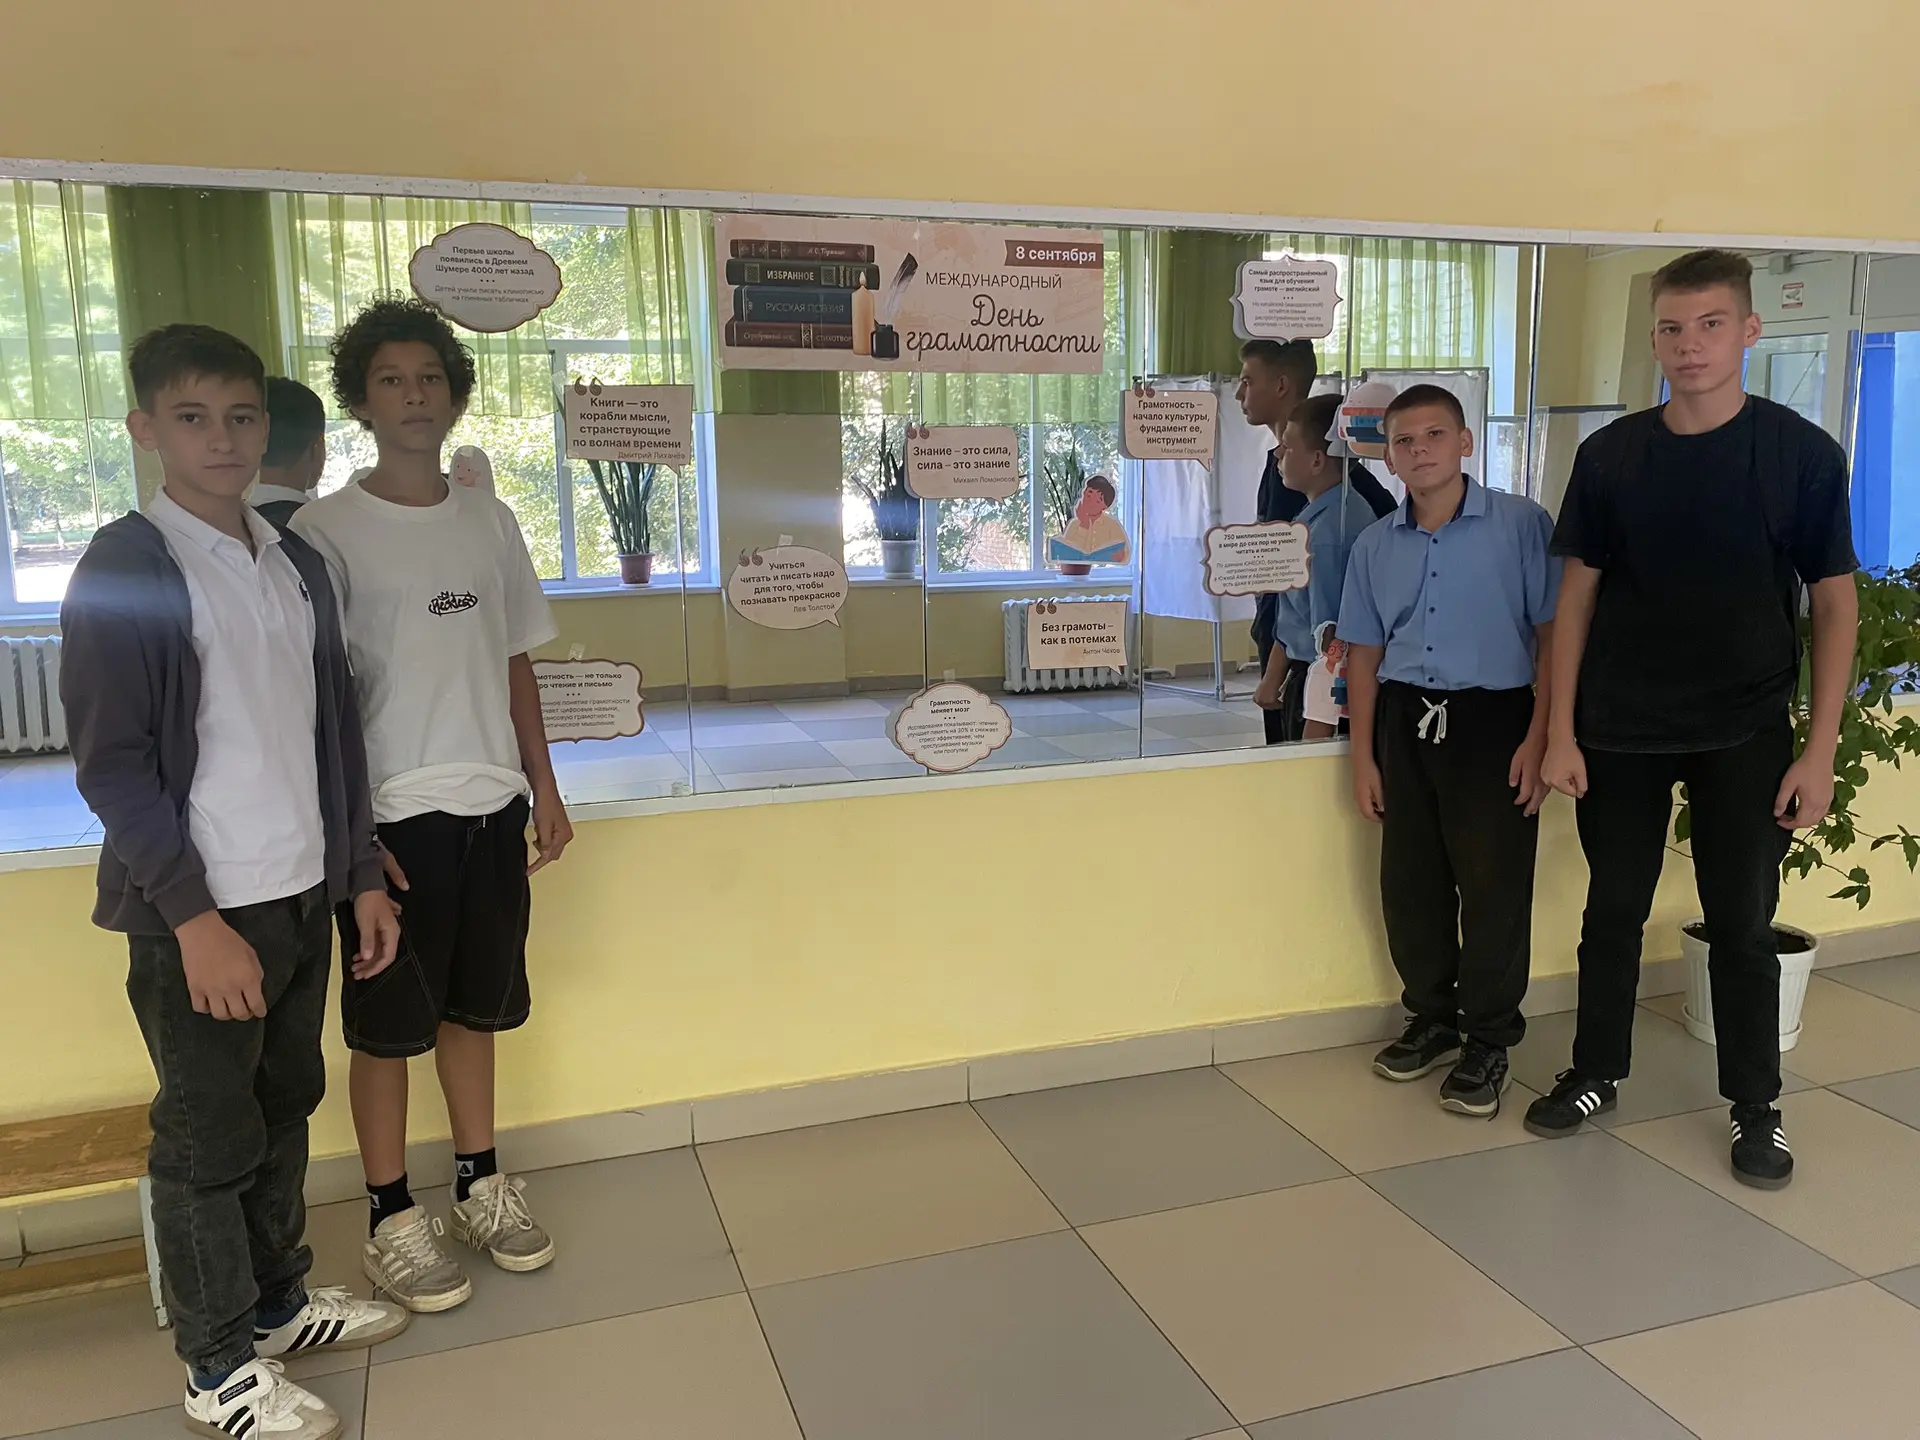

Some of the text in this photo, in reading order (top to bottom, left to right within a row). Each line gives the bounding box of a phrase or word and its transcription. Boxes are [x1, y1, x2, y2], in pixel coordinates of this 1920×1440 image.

[453, 247, 485, 255] Первые
[1015, 246, 1096, 264] 8 сентября
[440, 256, 483, 264] появились
[491, 258, 528, 266] Древнем
[435, 265, 469, 274] Шумере
[767, 270, 814, 280] ИЗБРАННОЕ
[926, 271, 1062, 290] МЕЖДУНАРОДНЫЙ
[765, 302, 805, 312] РУССКАЯ
[970, 294, 1044, 328] День
[906, 330, 1101, 362] грамотности
[590, 398, 624, 407] Книги
[640, 400, 659, 408] это
[1138, 400, 1195, 409] Грамотность
[580, 411, 670, 424] корабли мысли,
[1165, 414, 1209, 422] культуры,
[580, 426, 671, 436] странствующие
[1140, 425, 1187, 434] фундамент
[589, 440, 631, 448] волнам
[633, 441, 681, 449] времени
[1147, 437, 1196, 445] инструмент
[618, 451, 651, 460] Дмитрий
[913, 446, 1011, 456] Знание это сила,
[917, 460, 1010, 470] сила это знание
[769, 562, 805, 570] Учиться
[740, 575, 771, 583] читать
[781, 572, 811, 580] писать
[813, 570, 835, 578] надо
[754, 587, 770, 595] для
[796, 581, 824, 590] чтобы
[741, 592, 840, 606] познавать прекрасное
[793, 605, 806, 613] Лев
[1042, 623, 1106, 633] Без грамоты
[1041, 637, 1059, 645] как
[1069, 635, 1116, 644] потемках
[930, 700, 971, 708] Грамотность
[222, 1383, 245, 1398] adidas
